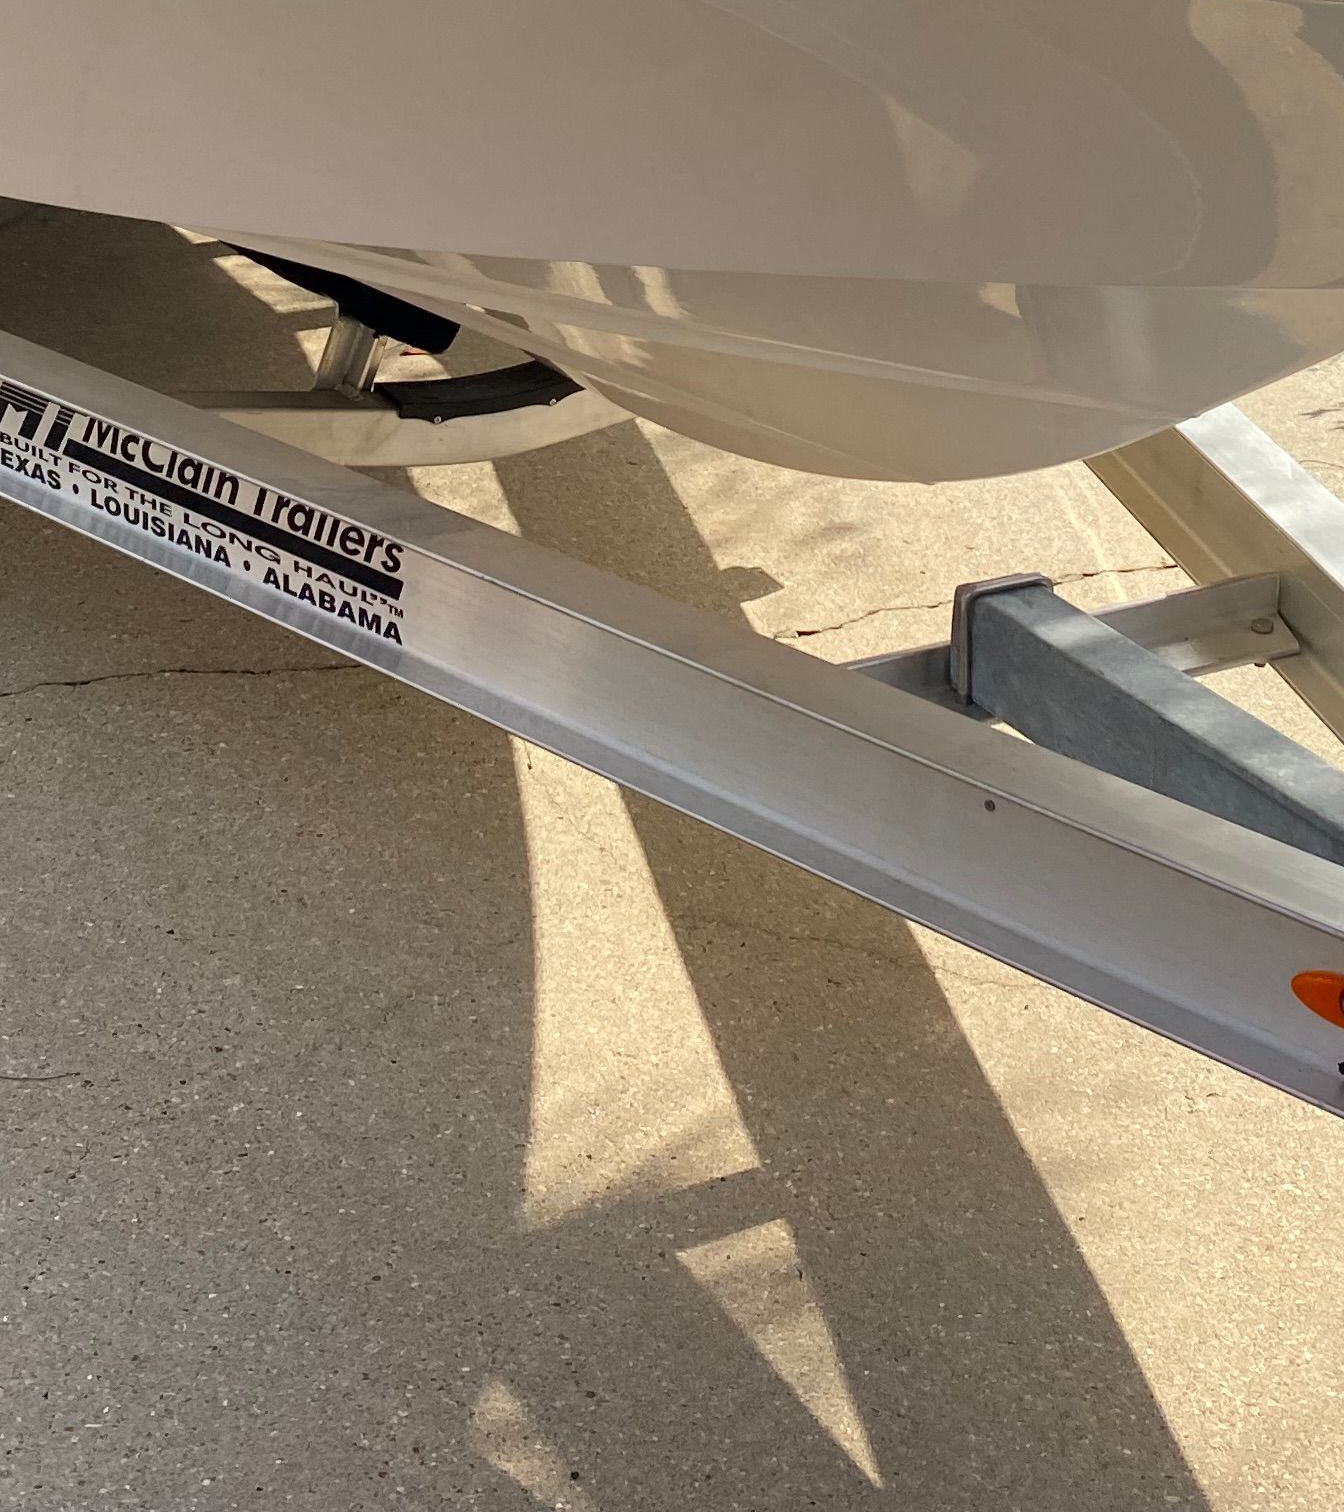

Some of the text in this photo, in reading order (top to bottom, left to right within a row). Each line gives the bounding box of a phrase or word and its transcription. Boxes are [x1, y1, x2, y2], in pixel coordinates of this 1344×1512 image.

[68, 461, 119, 494] FOR
[125, 487, 173, 518] THE
[183, 513, 281, 565] LONG
[82, 417, 240, 506] McClain
[253, 487, 405, 573] Trailers
[90, 488, 232, 569] LOUISIANA
[262, 567, 403, 646] ALABAMA
